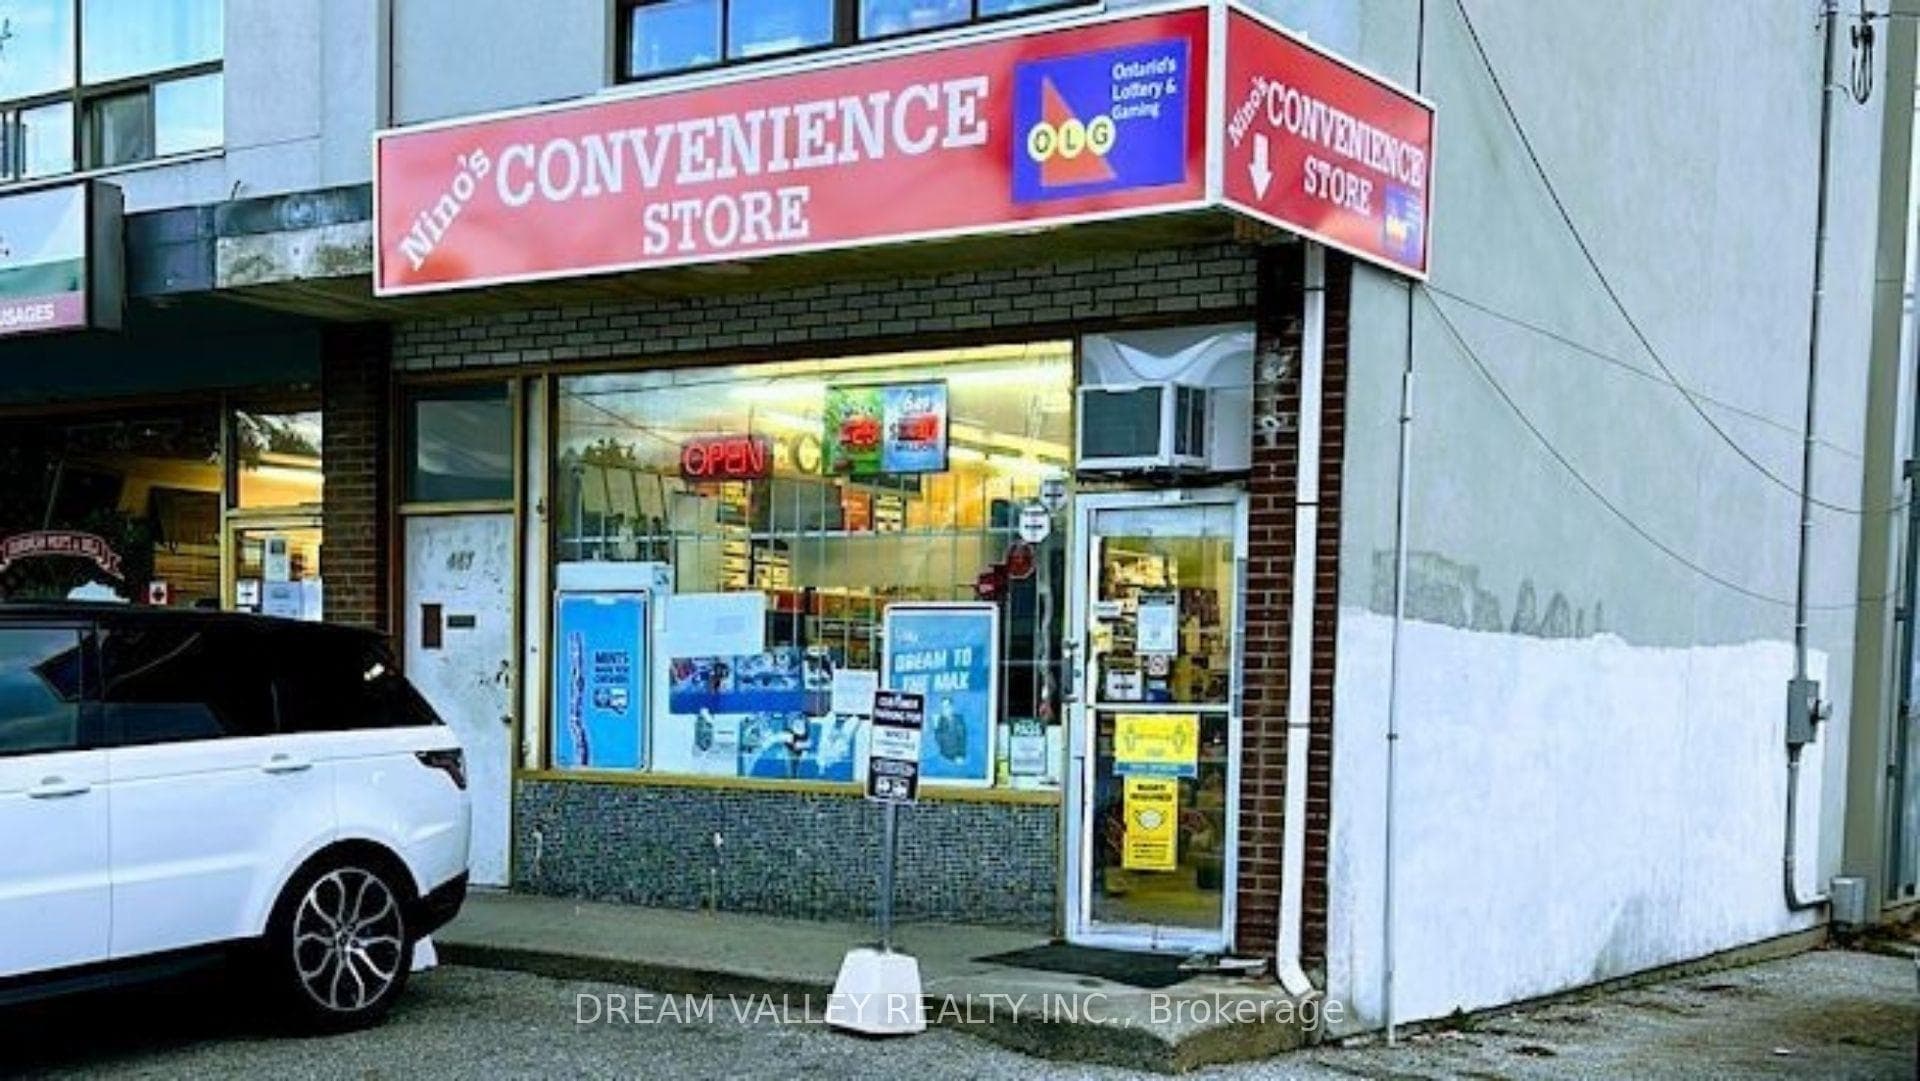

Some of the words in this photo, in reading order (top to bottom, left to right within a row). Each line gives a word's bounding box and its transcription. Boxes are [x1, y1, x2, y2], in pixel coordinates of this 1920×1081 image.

[1112, 56, 1177, 80] Ontario's
[1112, 80, 1164, 101] Lottery
[1111, 102, 1160, 120] Gaming
[1032, 121, 1110, 155] OLG
[1228, 76, 1268, 148] Nino's
[1266, 80, 1425, 188] CONVENIENCE
[397, 147, 491, 272] Nino's
[496, 75, 990, 207] CONVENIENCE
[1303, 154, 1374, 217] STORE
[642, 186, 812, 256] STORE
[685, 438, 765, 477] OPEN
[894, 648, 947, 673] DREAM
[953, 646, 973, 668] TO
